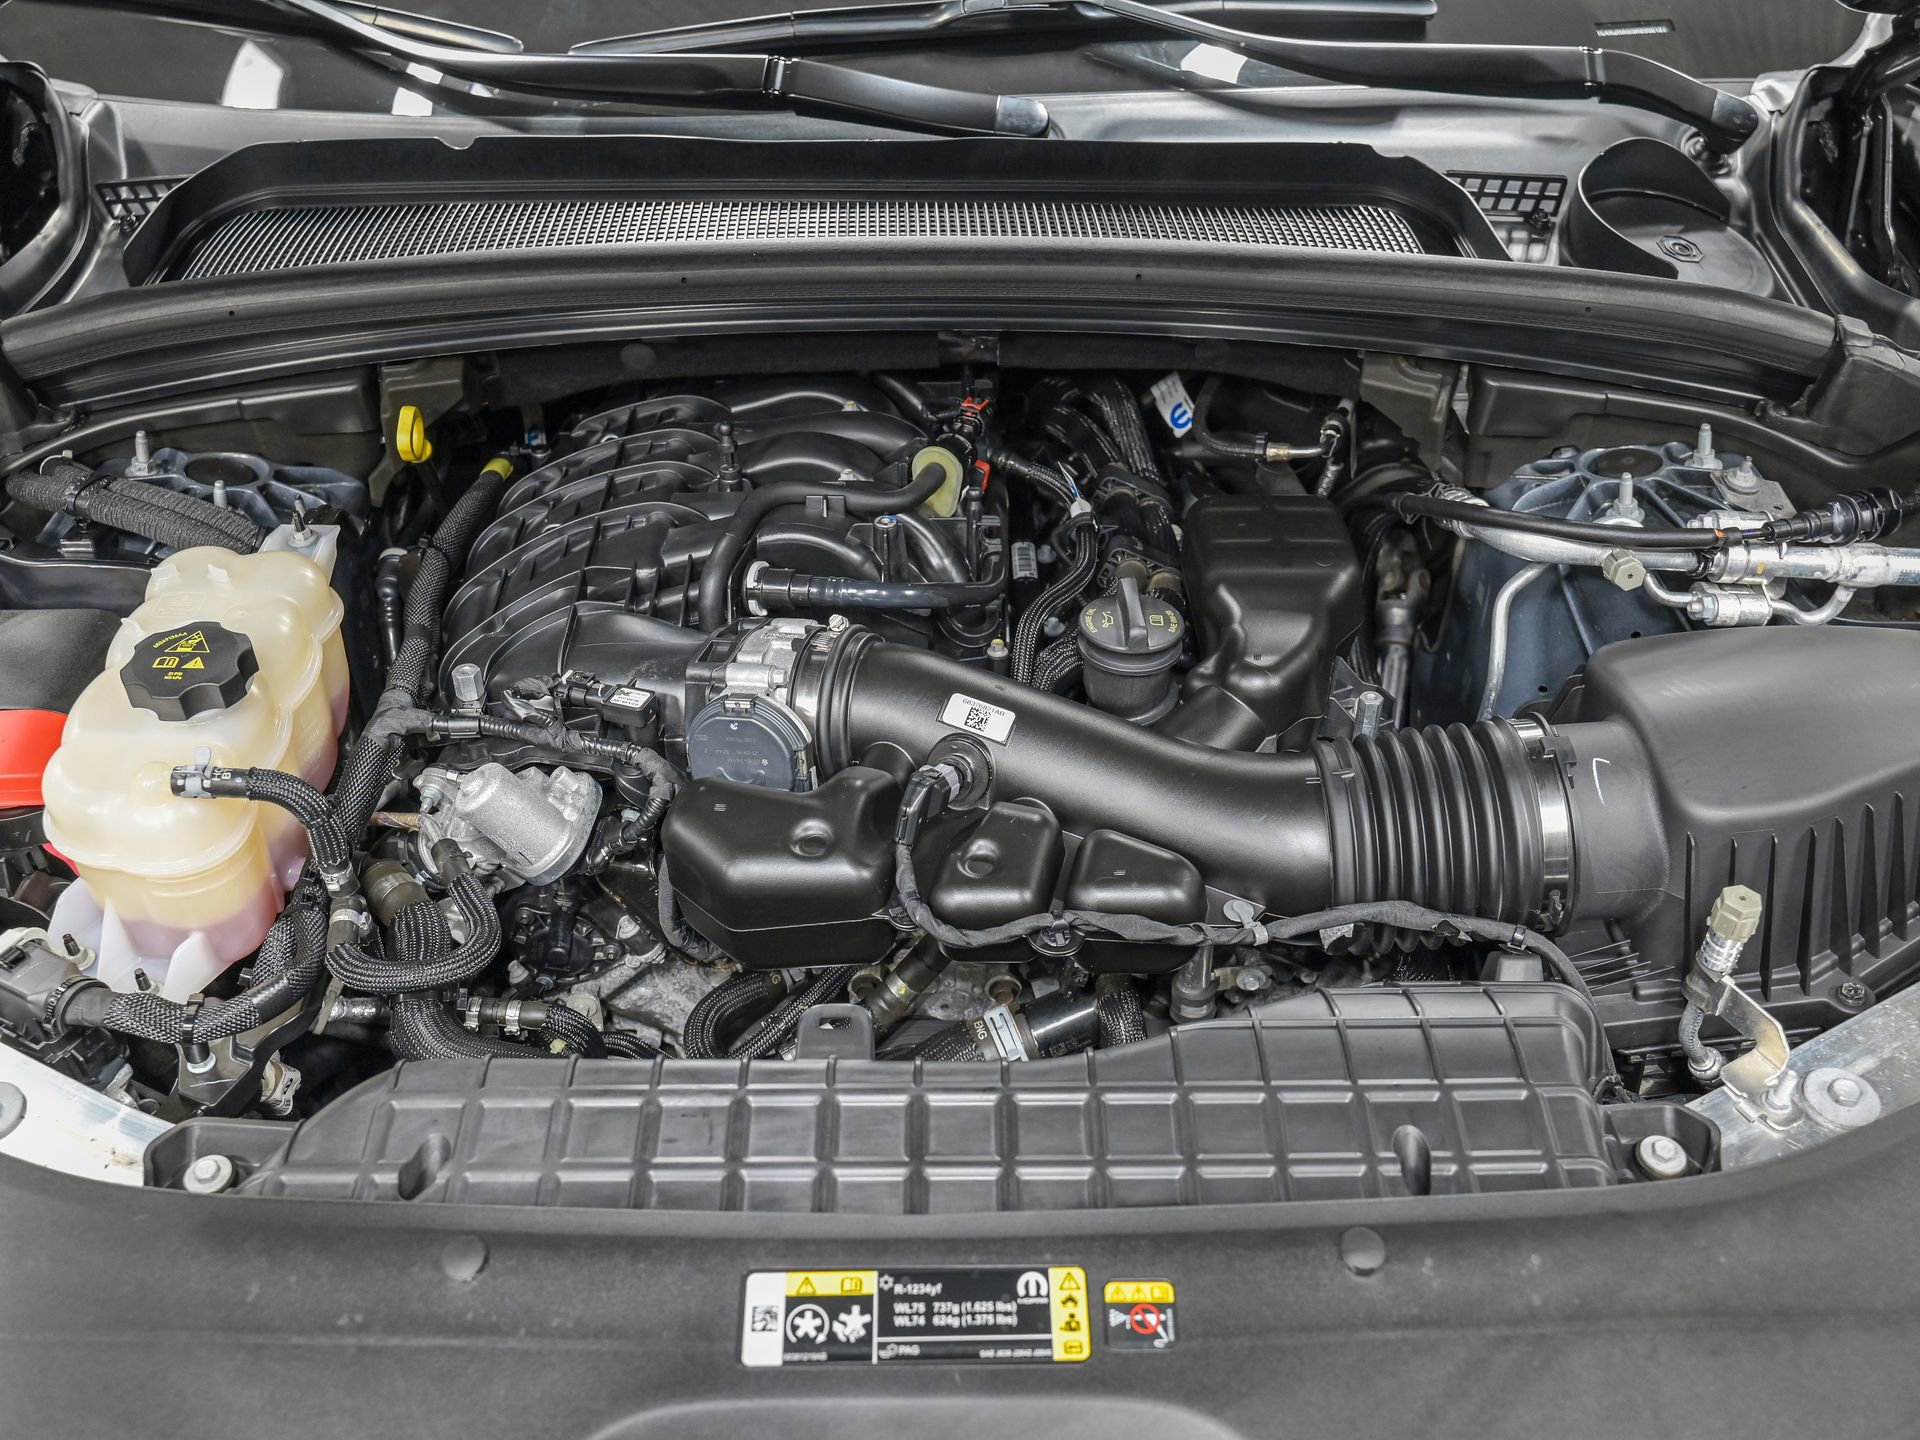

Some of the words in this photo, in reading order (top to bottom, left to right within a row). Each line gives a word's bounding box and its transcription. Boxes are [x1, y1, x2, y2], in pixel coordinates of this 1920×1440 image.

[1085, 616, 1099, 633] ENGINE
[973, 1020, 988, 1040] ENG
[893, 1282, 943, 1297] R-1234yf
[893, 1302, 926, 1314] WL75
[932, 1302, 961, 1315] 737g
[995, 1301, 1018, 1314] lbs)
[893, 1315, 926, 1327] WL74
[932, 1315, 961, 1328] 624g
[995, 1314, 1018, 1327] lbs)
